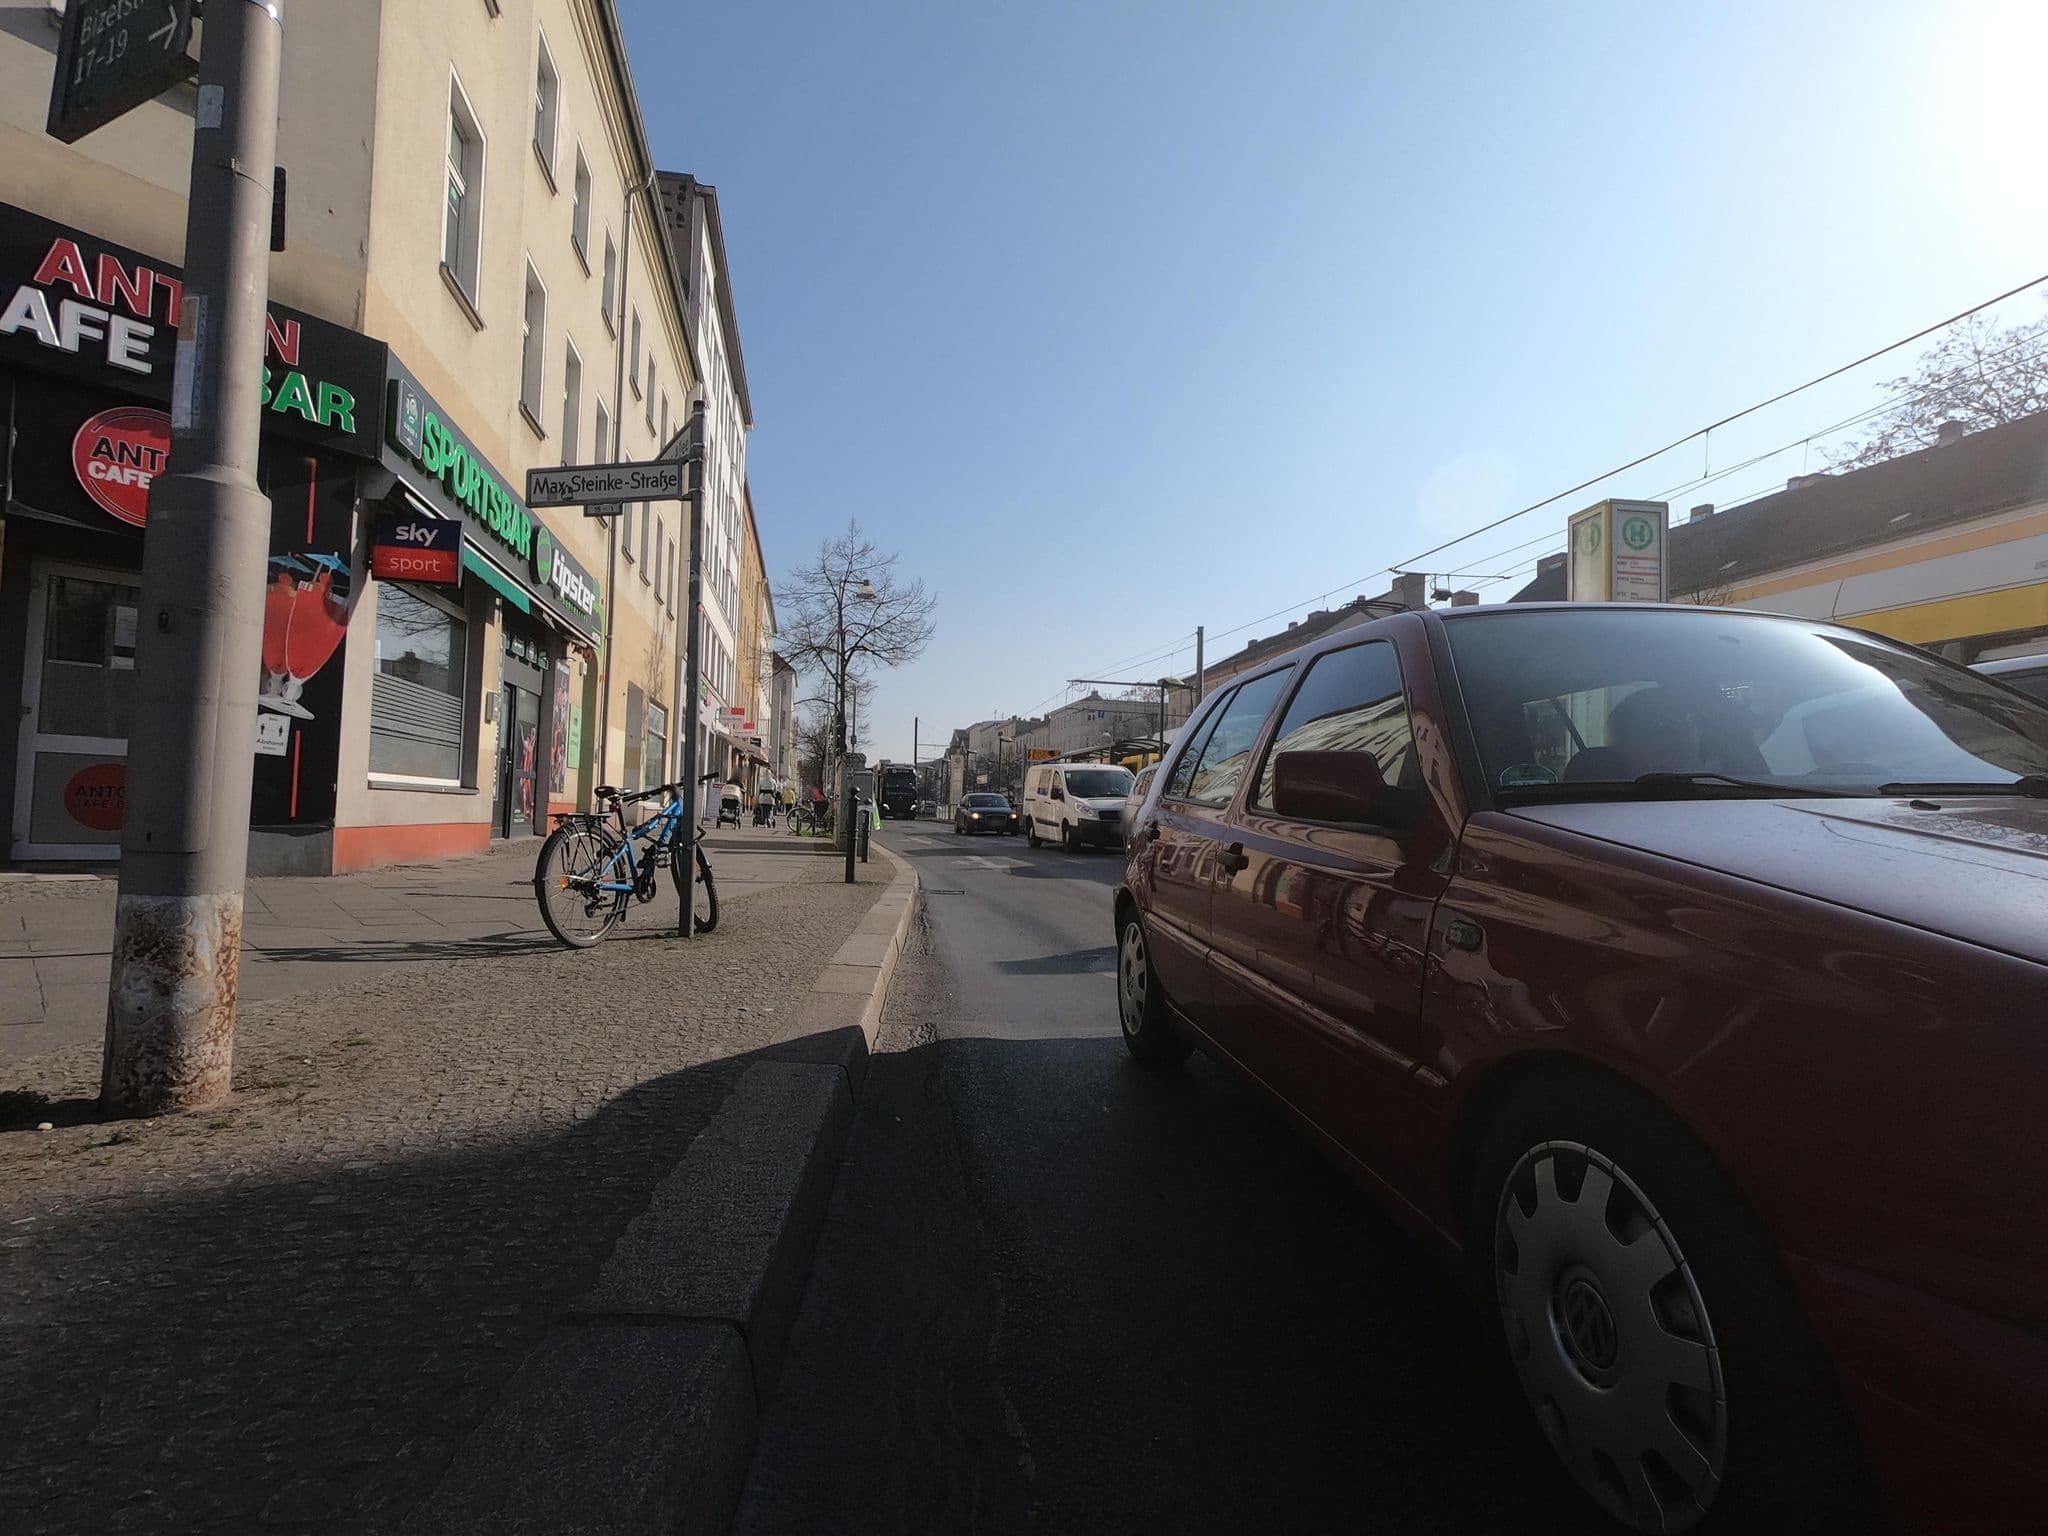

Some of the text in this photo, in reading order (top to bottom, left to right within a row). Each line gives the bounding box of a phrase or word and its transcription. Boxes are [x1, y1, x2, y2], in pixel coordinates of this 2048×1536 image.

[74, 29, 128, 85] 17-19
[89, 435, 167, 473] ANT
[87, 460, 154, 490] CAFE
[423, 411, 532, 561] SPORTSBAR
[533, 471, 677, 495] MaxSteinke-Straße
[395, 521, 438, 546] sky
[389, 555, 441, 573] sport
[552, 548, 596, 616] tipster
